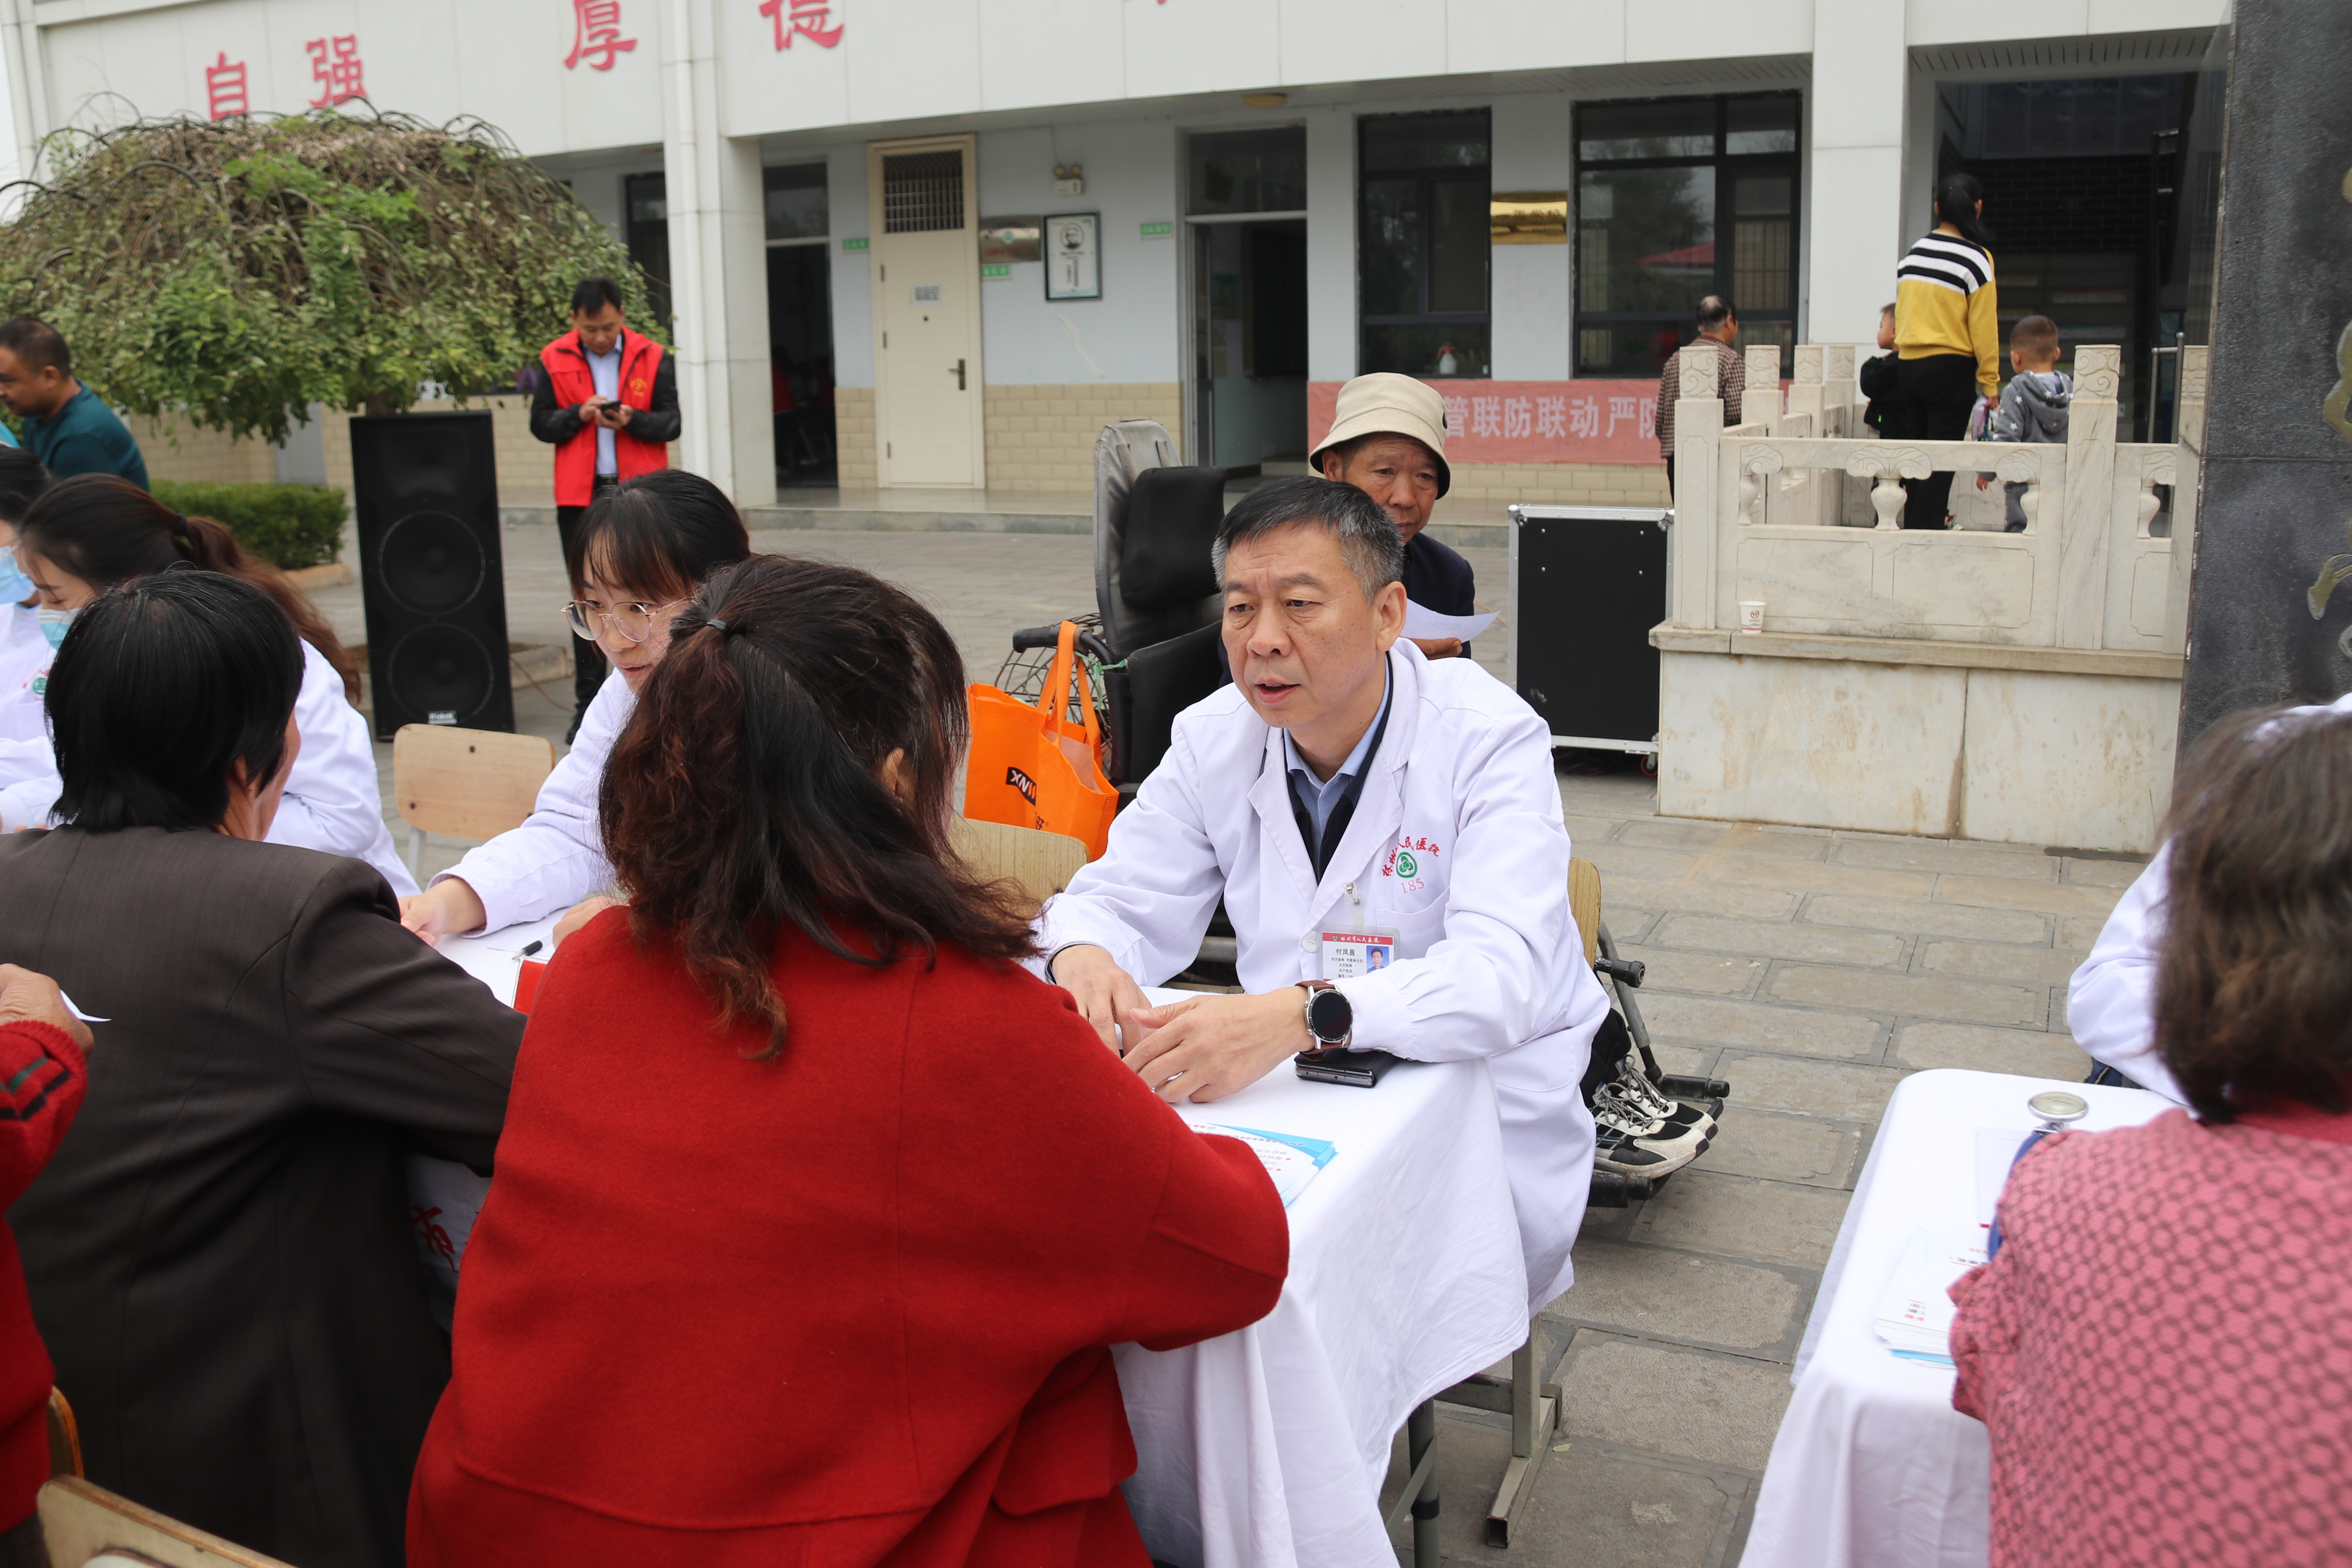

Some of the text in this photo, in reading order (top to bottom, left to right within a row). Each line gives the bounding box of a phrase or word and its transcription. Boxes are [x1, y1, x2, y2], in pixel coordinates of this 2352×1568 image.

[206, 32, 368, 121] 自强
[1400, 877, 1425, 894] 185
[1336, 948, 1355, 956] 付风昌
